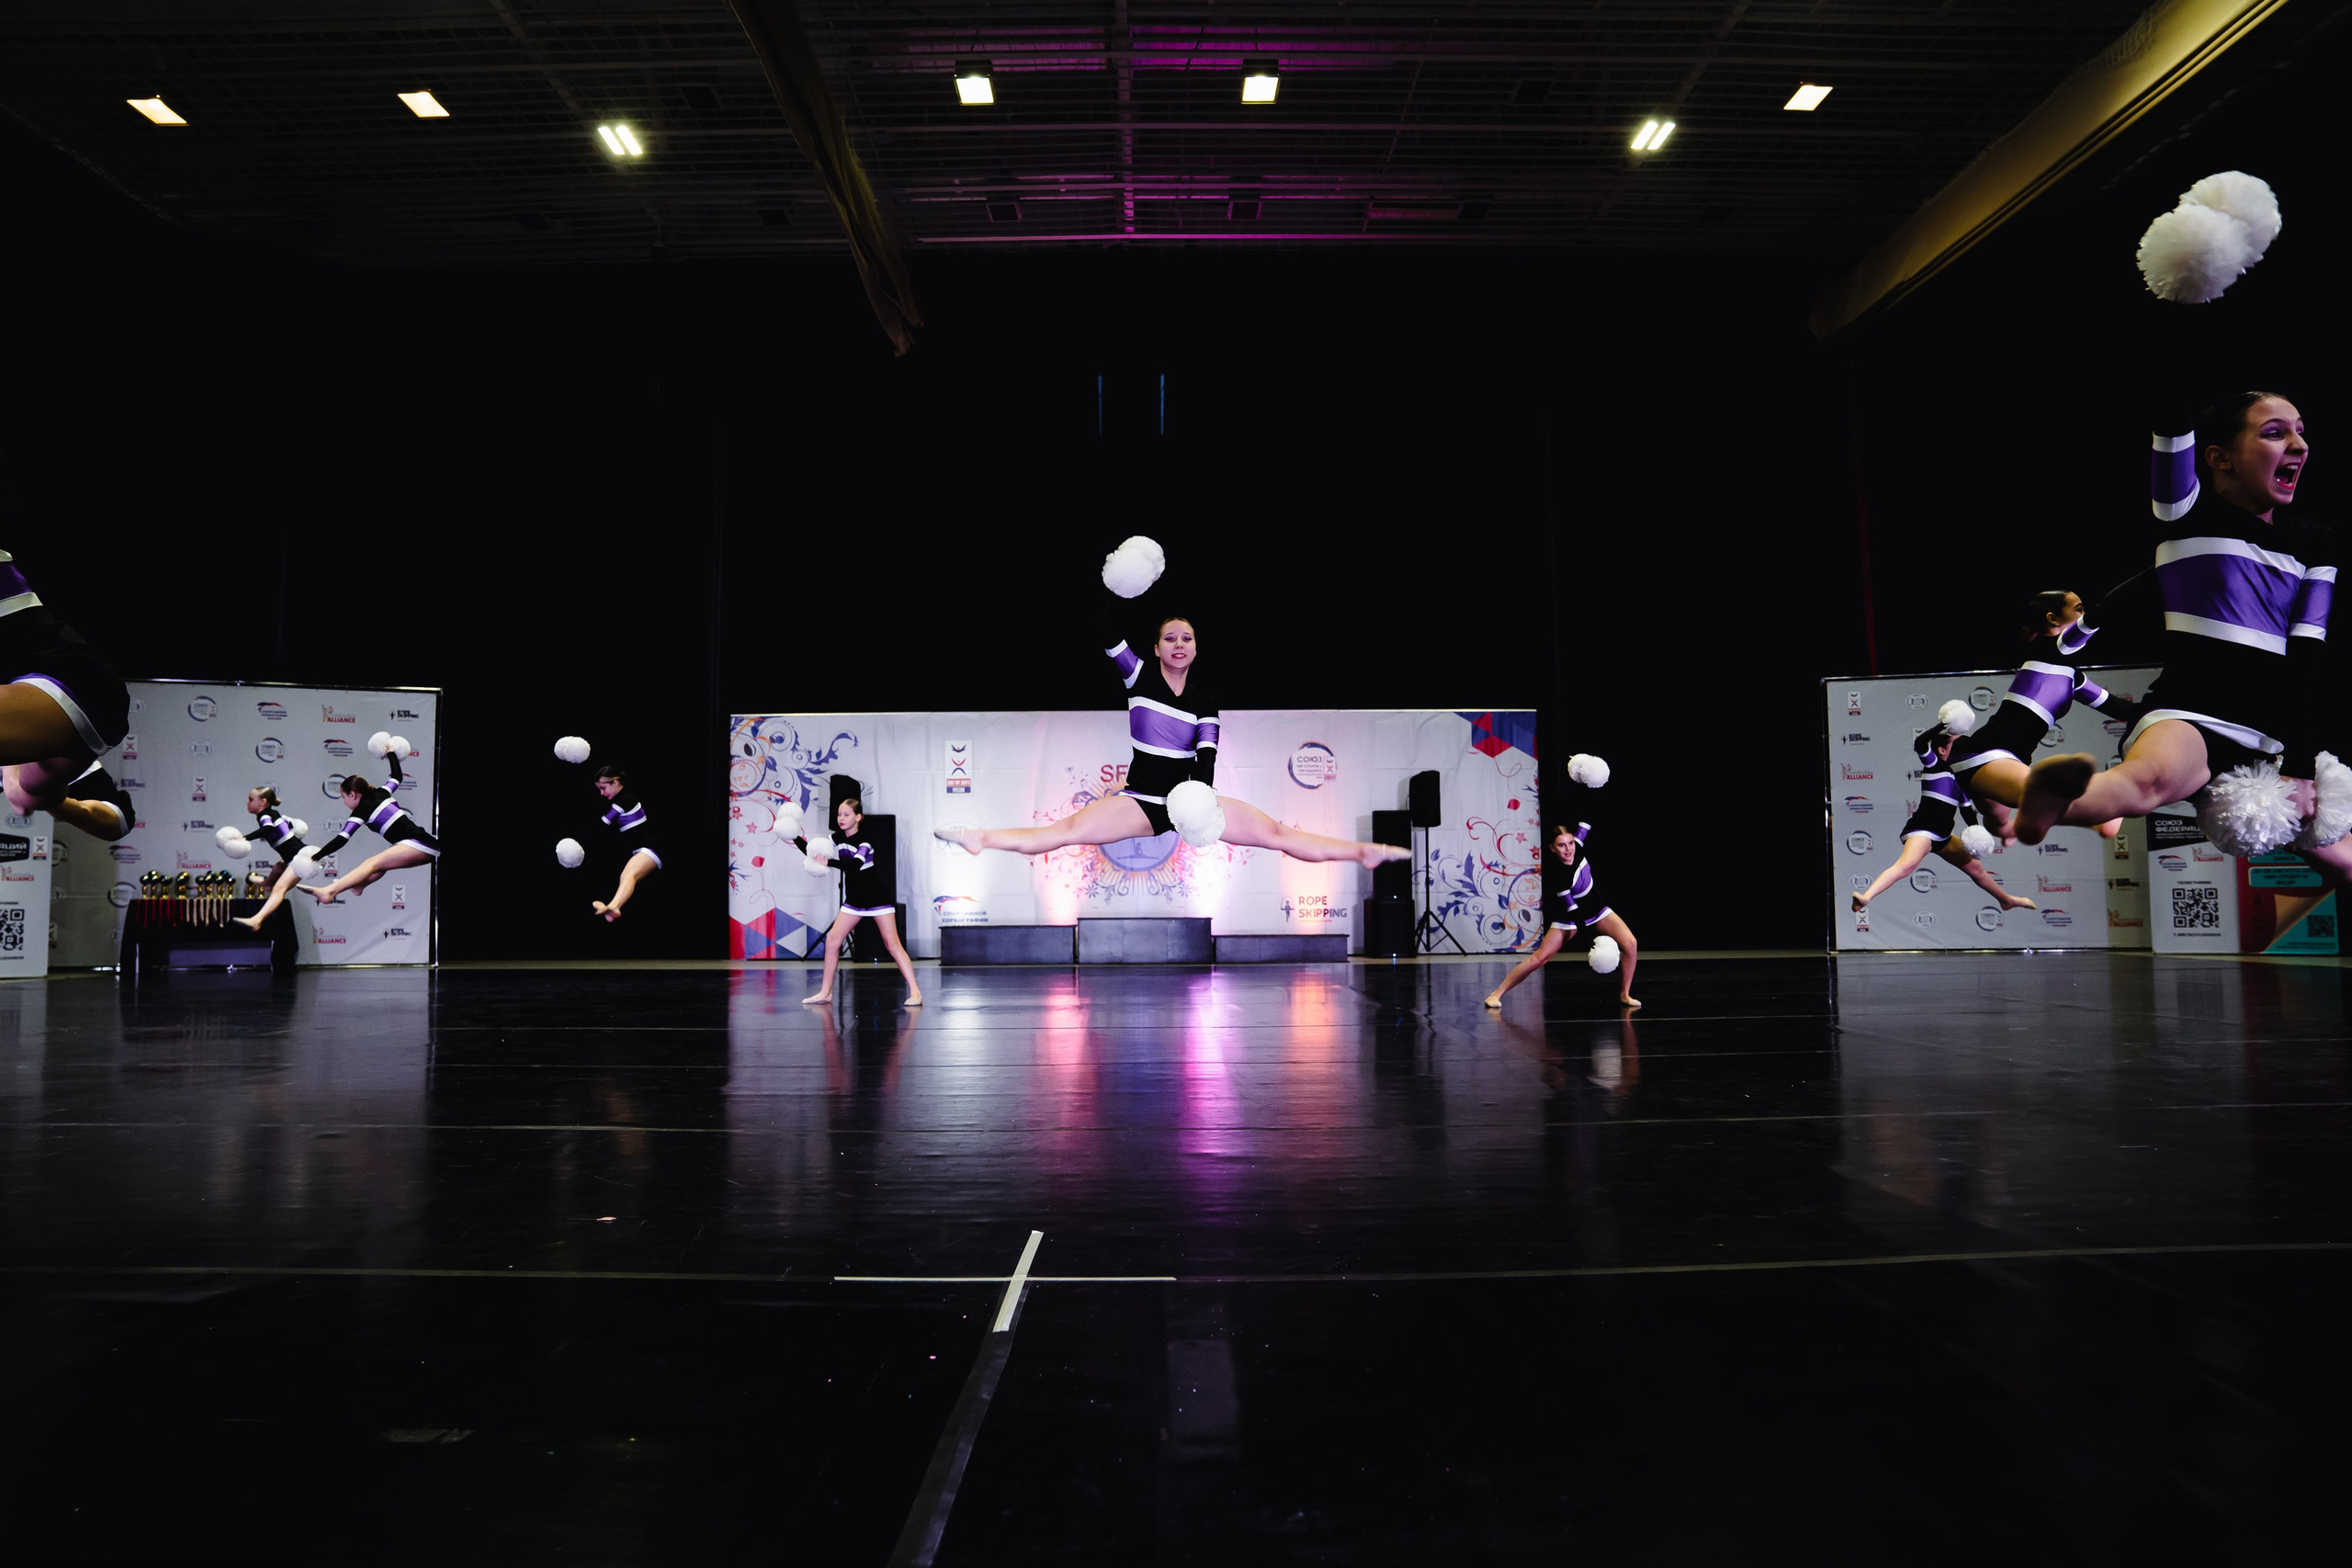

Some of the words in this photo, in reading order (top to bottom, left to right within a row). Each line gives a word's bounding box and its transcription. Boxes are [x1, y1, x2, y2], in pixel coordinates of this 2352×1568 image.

[1296, 755, 1323, 763] СОЮЗ
[1298, 896, 1328, 906] ROPE
[1298, 908, 1348, 919] SKIPPING
[2113, 919, 2144, 928] ALLIANCE
